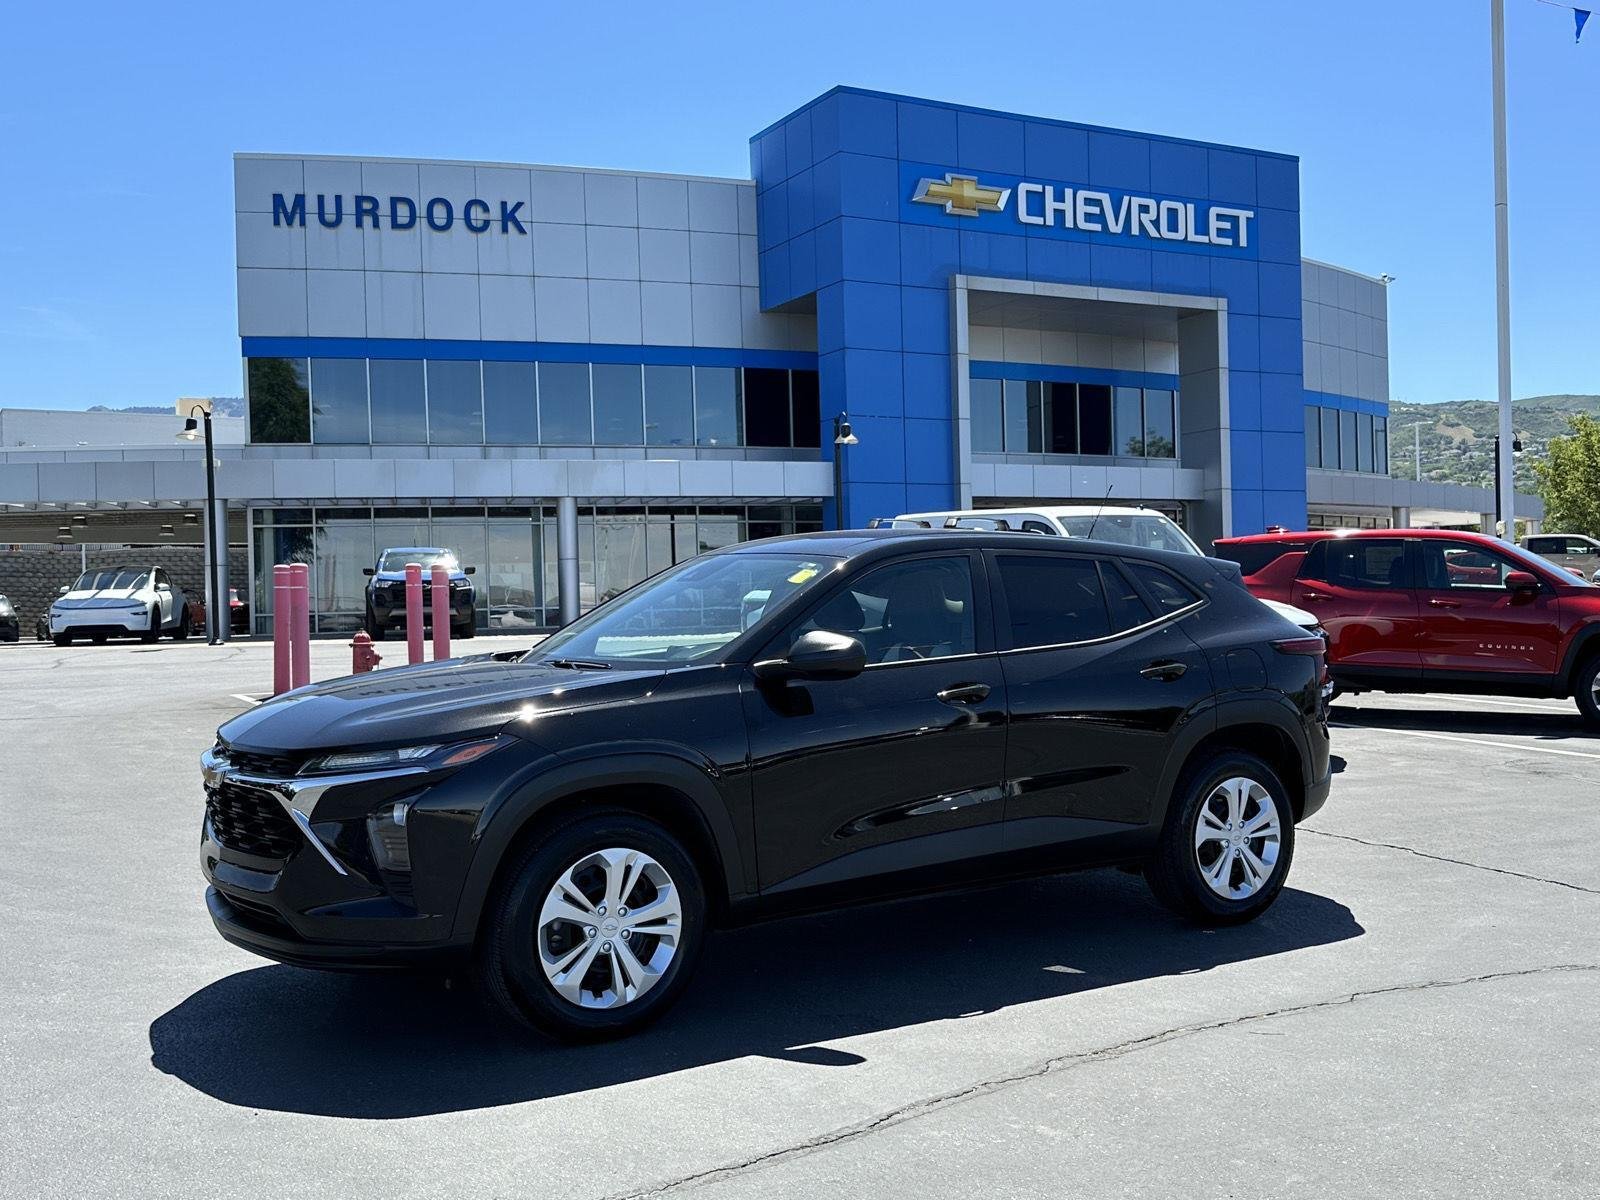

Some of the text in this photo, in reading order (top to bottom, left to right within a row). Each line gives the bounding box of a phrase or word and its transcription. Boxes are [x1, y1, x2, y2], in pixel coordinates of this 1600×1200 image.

[272, 193, 527, 235] MURDOCK
[1018, 182, 1254, 247] CHEVROLET
[1479, 643, 1534, 651] EQUINOX
